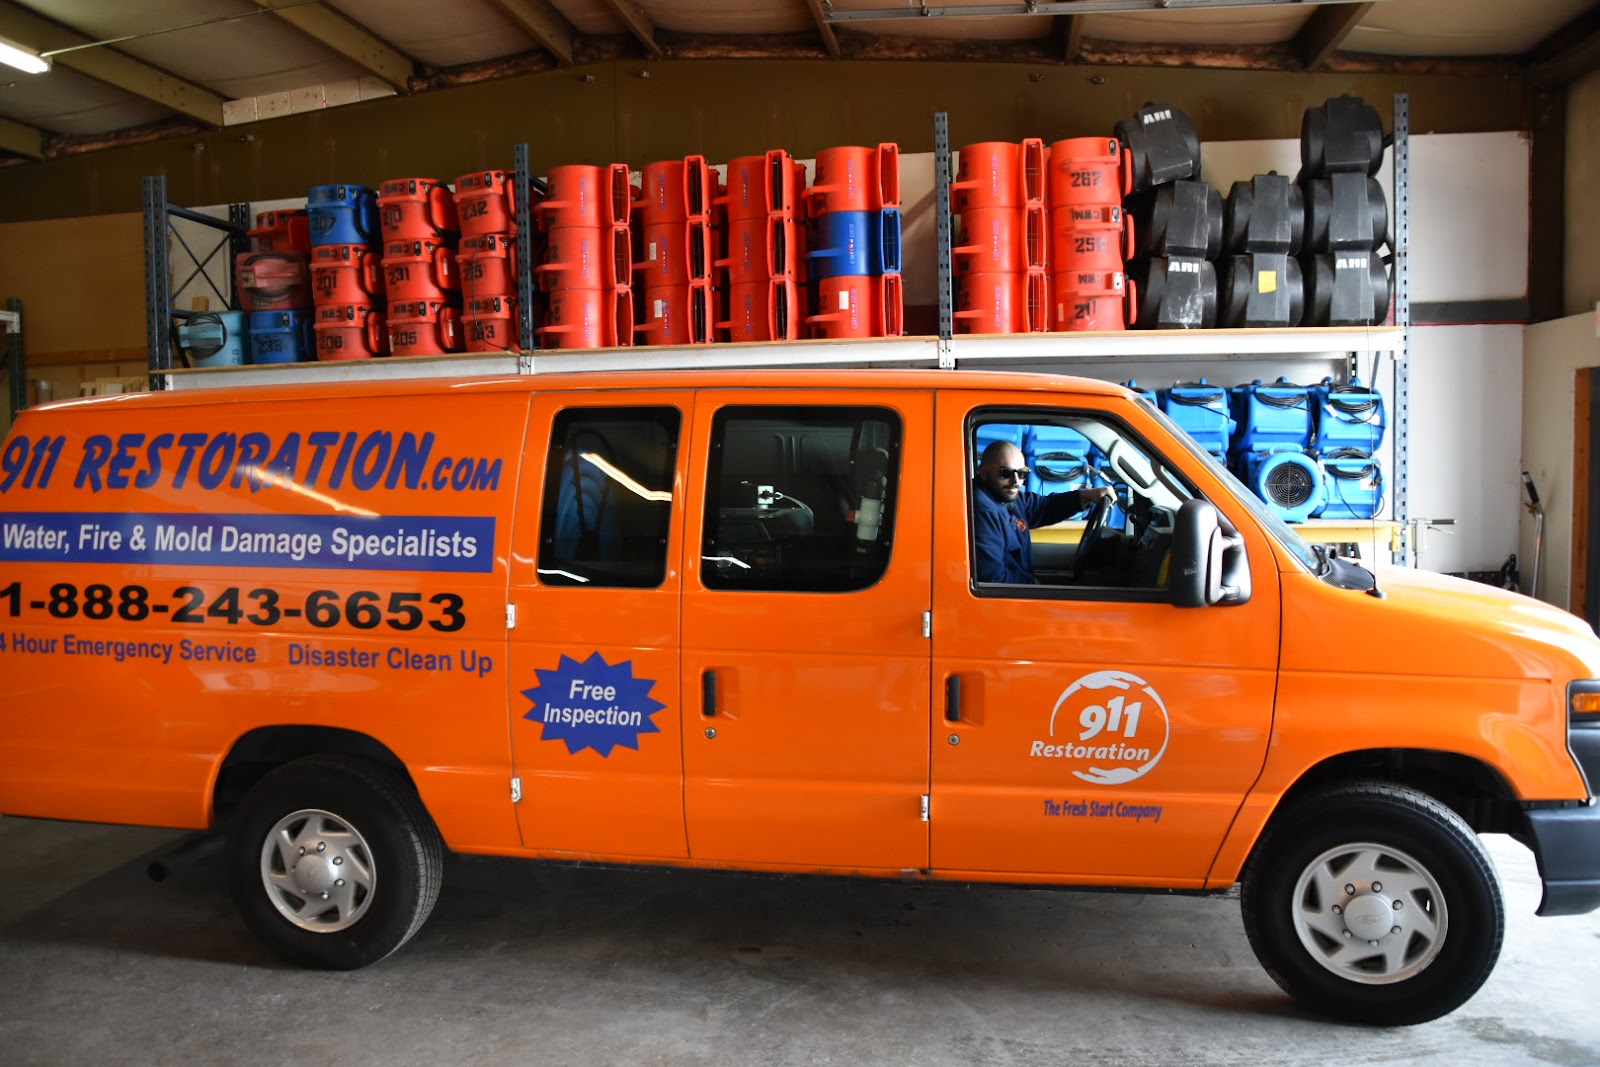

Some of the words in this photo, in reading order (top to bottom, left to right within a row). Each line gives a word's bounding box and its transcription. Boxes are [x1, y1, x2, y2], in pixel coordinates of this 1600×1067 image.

[389, 266, 410, 285] 231
[393, 331, 417, 346] 205
[0, 435, 66, 494] 911
[3, 523, 70, 554] Water,
[78, 524, 122, 550] Fire
[129, 524, 147, 550] &
[155, 525, 213, 552] Mold
[220, 526, 322, 561] Damage
[331, 527, 477, 561] Specialists
[0, 582, 466, 632] 1-888-243-6653
[13, 633, 58, 653] Hour
[64, 634, 173, 664] Emergency
[180, 639, 257, 663] Service
[288, 643, 380, 668] Disaster
[387, 647, 452, 671] Clean
[461, 649, 493, 677] Up
[569, 679, 616, 701] Free
[543, 703, 642, 728] Inspection
[1079, 695, 1142, 741] 911
[1030, 740, 1150, 761] Restoration
[1044, 799, 1061, 816] The
[1063, 800, 1088, 816] Fresh
[1090, 801, 1114, 817] Start
[1116, 801, 1163, 823] Company
